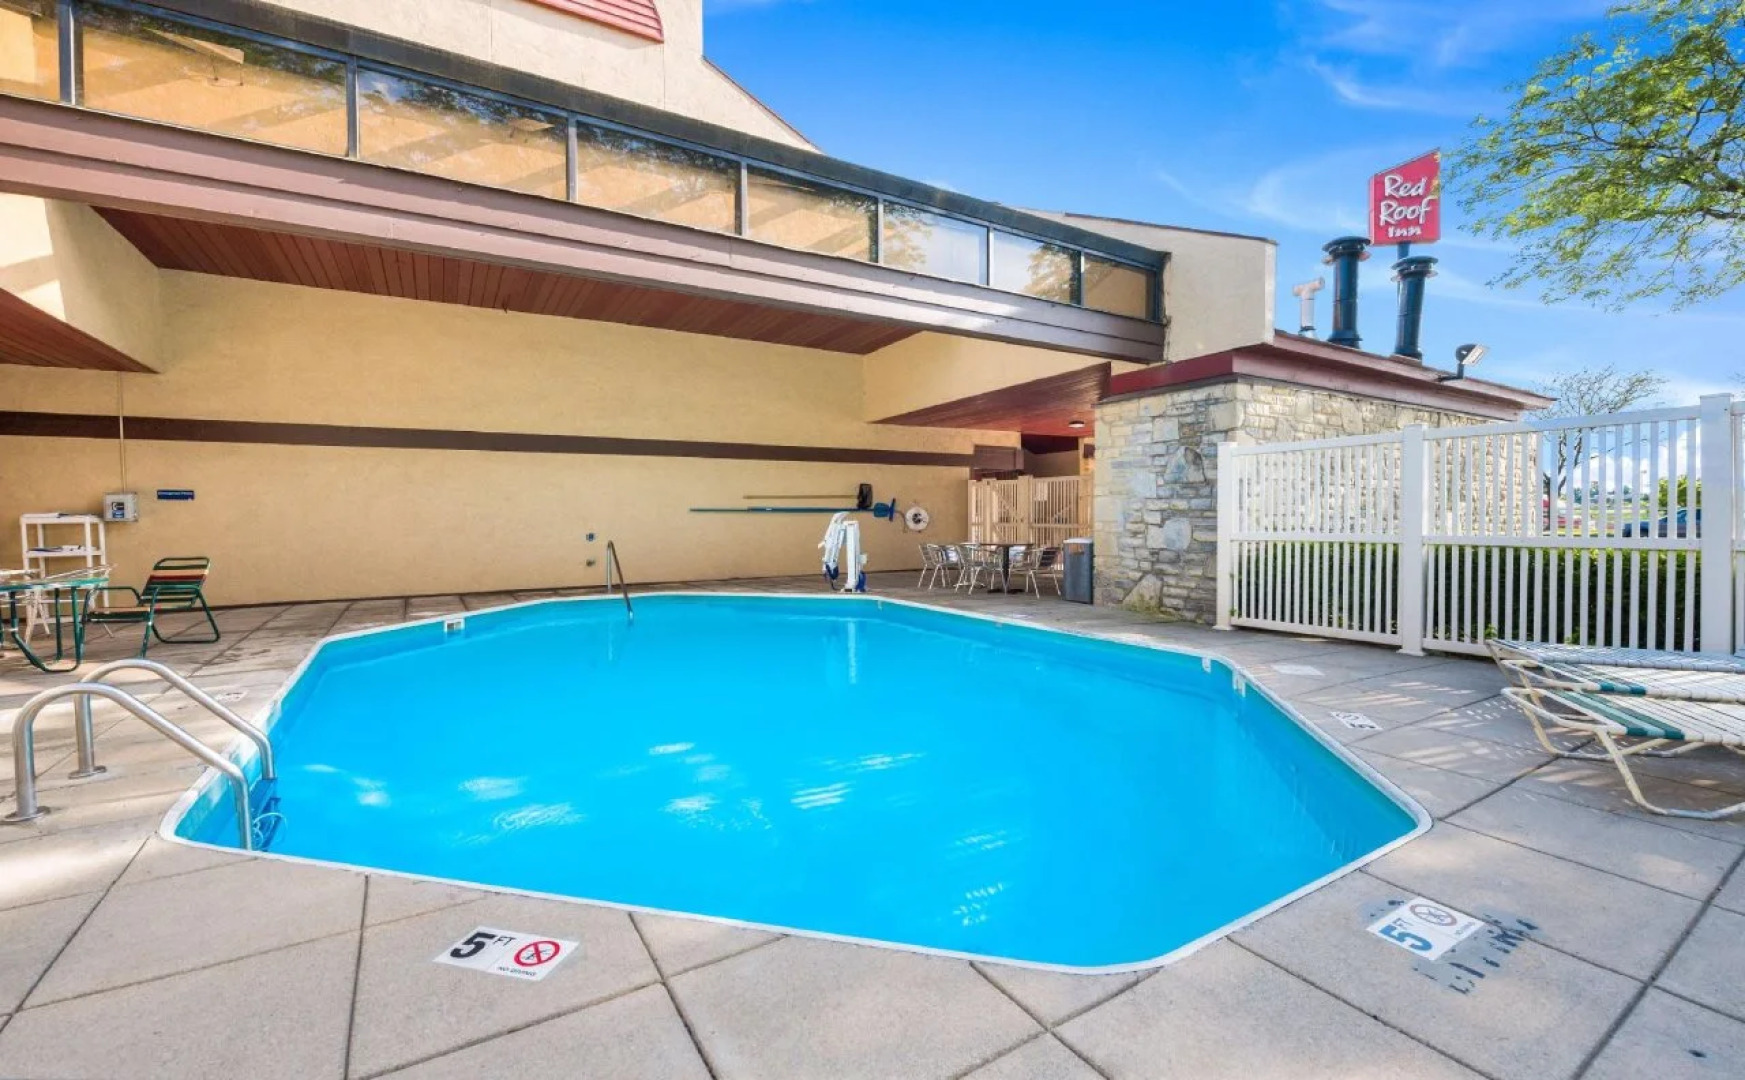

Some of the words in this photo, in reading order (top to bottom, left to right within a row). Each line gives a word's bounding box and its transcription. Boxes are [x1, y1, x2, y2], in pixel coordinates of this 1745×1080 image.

[1384, 175, 1427, 198] Red
[1380, 195, 1438, 226] Roof
[450, 932, 497, 958] 5
[493, 936, 516, 947] FT
[1379, 925, 1433, 951] 5
